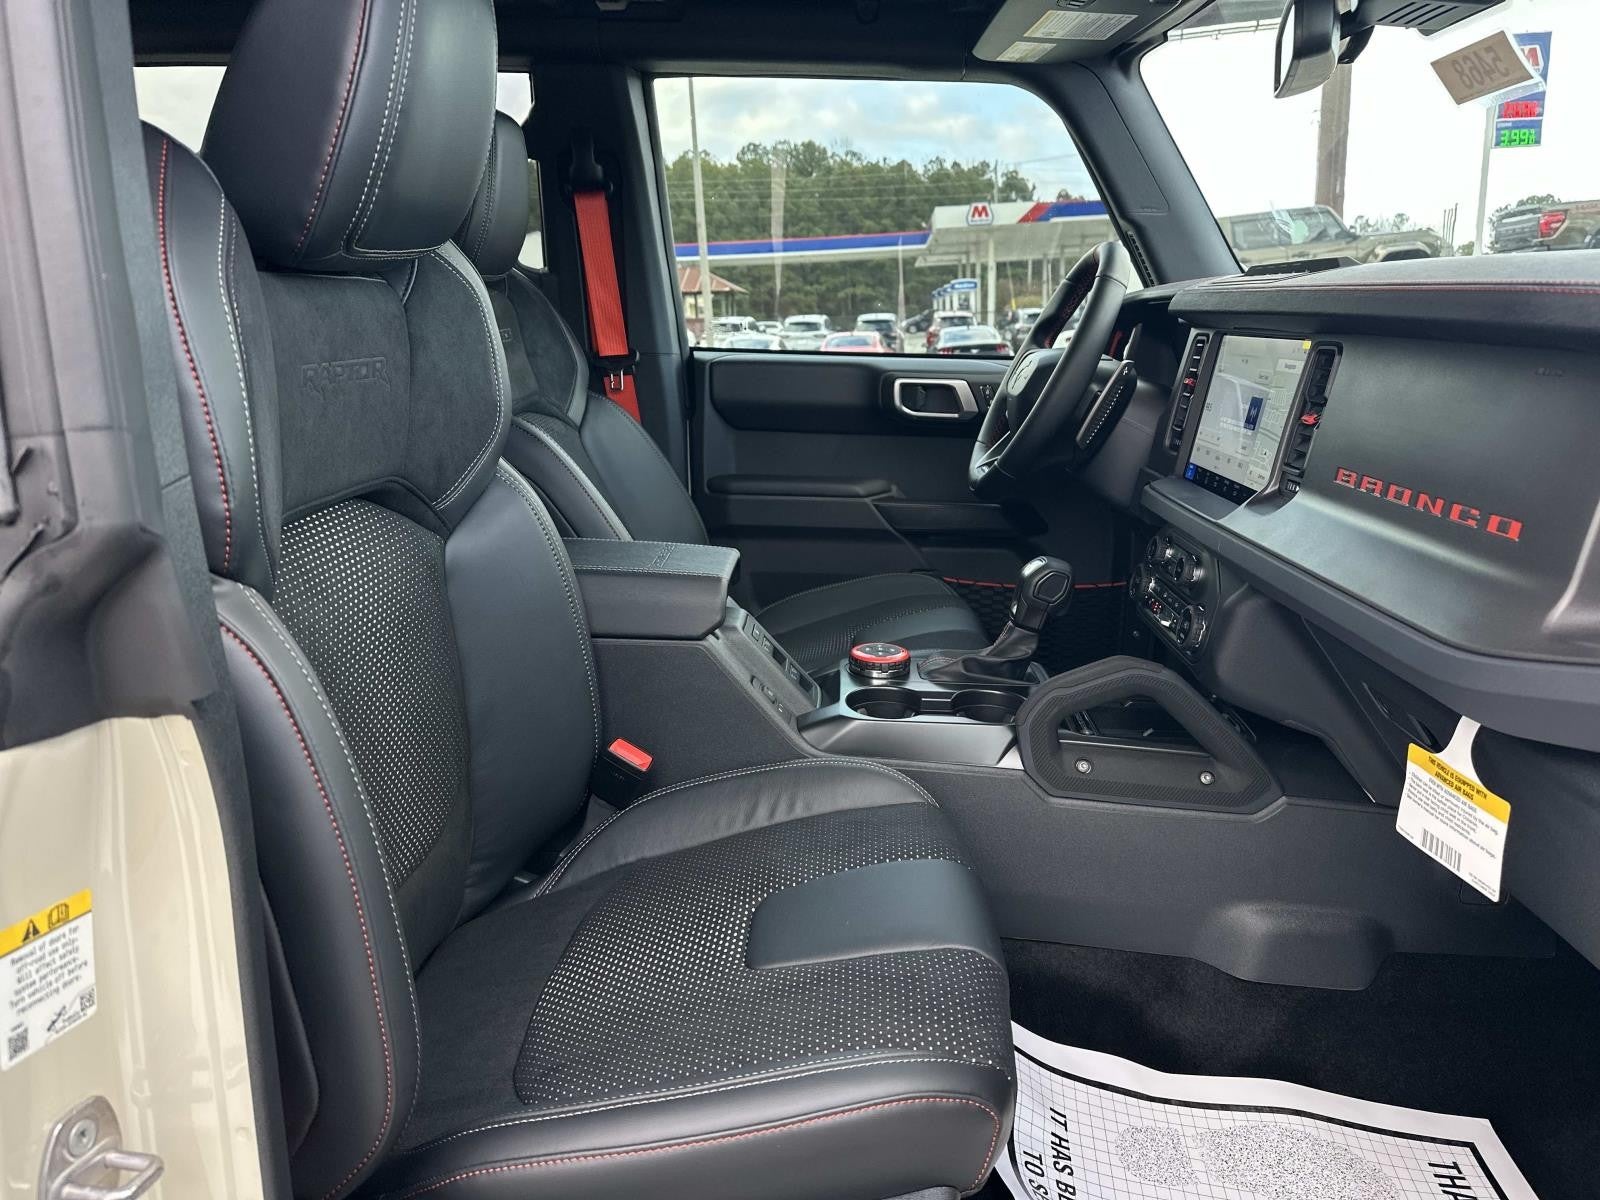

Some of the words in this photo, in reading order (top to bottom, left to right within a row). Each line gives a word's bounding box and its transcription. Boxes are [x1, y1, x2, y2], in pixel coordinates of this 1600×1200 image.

[972, 206, 989, 218] M
[300, 356, 391, 400] RAPTOR
[1333, 466, 1523, 542] BRONCO
[1434, 770, 1454, 787] ADVANCED
[1462, 788, 1473, 800] BAGS
[1436, 761, 1449, 776] VEHICLE
[1454, 774, 1474, 792] EQUIPPED
[1475, 787, 1486, 799] WITH
[1050, 1106, 1068, 1132] IT
[1023, 1150, 1044, 1177] TO
[1050, 1132, 1074, 1176] HAS
